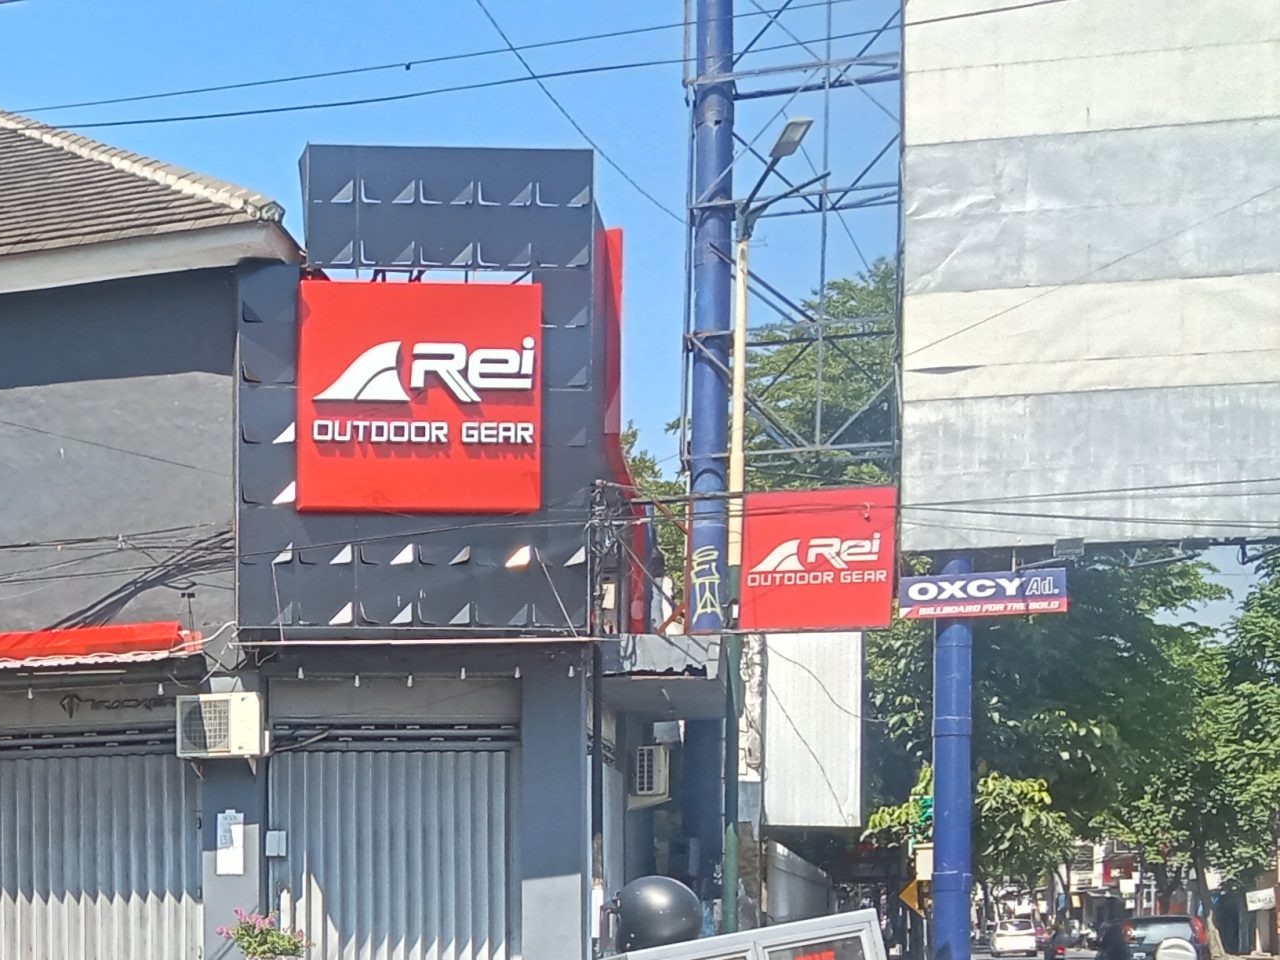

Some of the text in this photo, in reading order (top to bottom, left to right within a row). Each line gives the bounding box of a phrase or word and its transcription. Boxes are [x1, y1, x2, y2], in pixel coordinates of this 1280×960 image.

[410, 335, 536, 403] Rei
[312, 419, 535, 444] OUTDOOR GEAR
[806, 531, 881, 570] Rei
[747, 570, 888, 587] OUTDOOR GEAR
[908, 577, 1026, 601] OXCY
[918, 599, 1060, 617] BILLBOARD FOR THE BOLD
